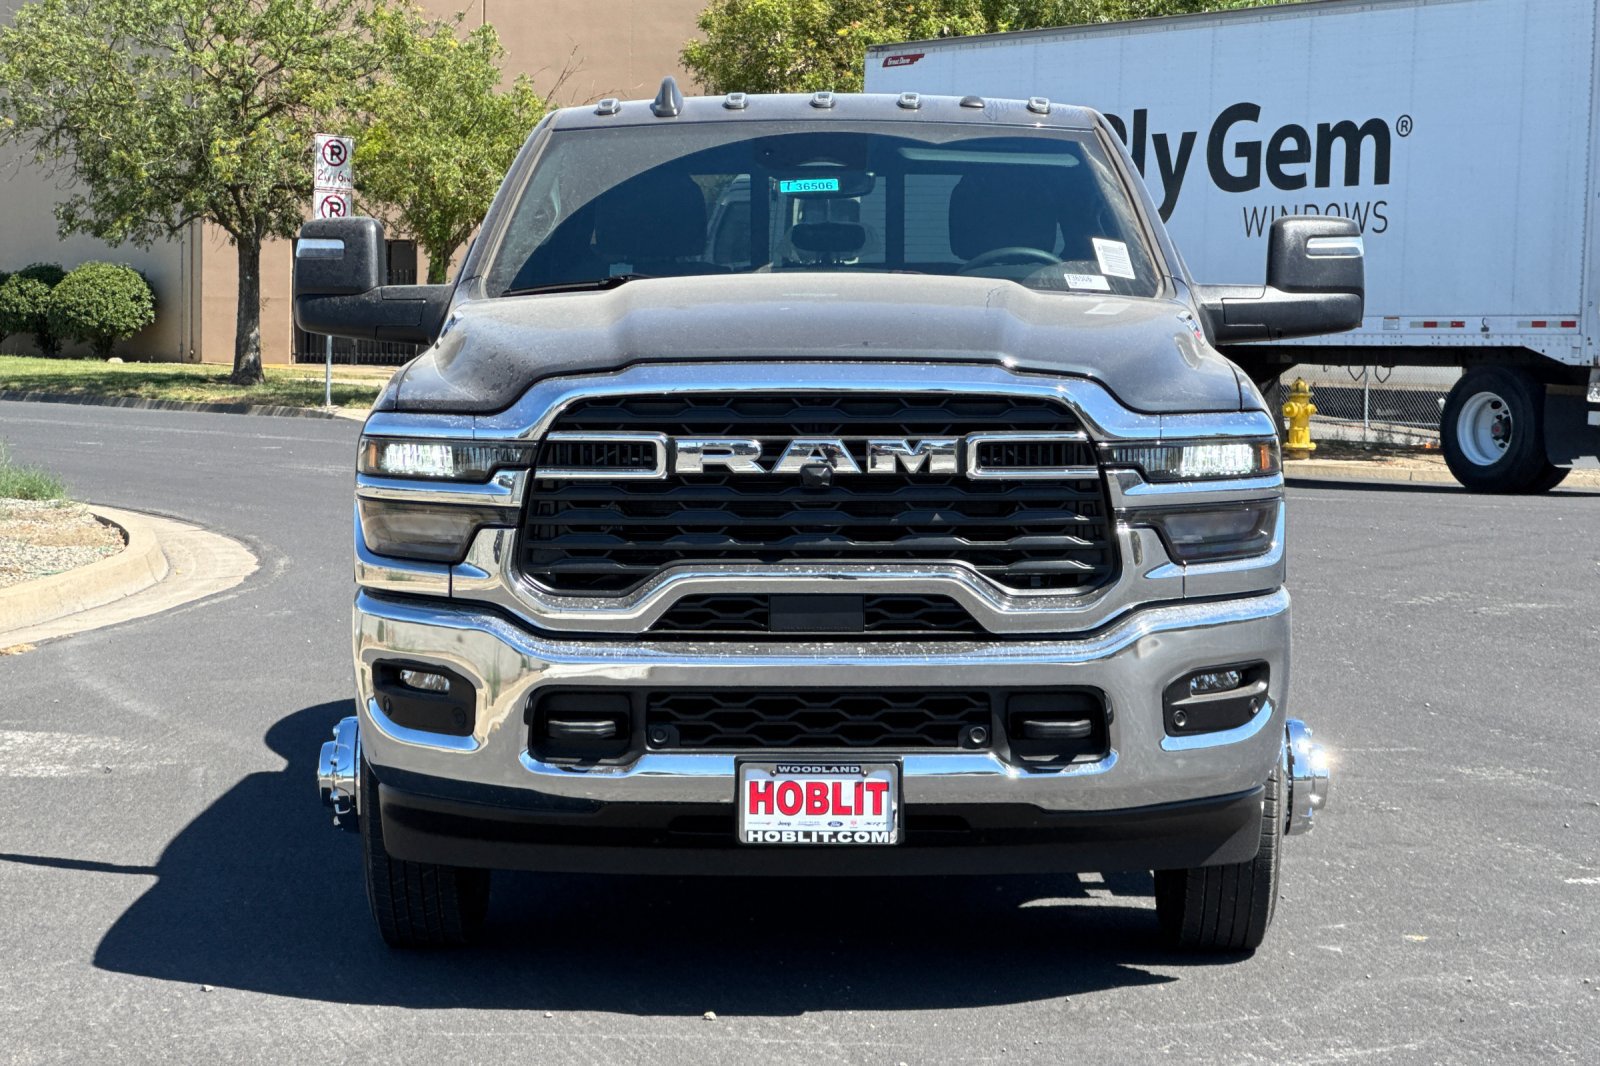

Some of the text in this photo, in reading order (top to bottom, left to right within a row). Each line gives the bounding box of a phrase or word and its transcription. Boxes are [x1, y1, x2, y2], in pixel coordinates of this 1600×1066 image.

[796, 181, 833, 191] 36506
[674, 438, 958, 474] RAM
[777, 765, 860, 774] WOODLAND
[748, 780, 890, 816] HOBLIT
[747, 830, 889, 843] HOBLIT.COM
